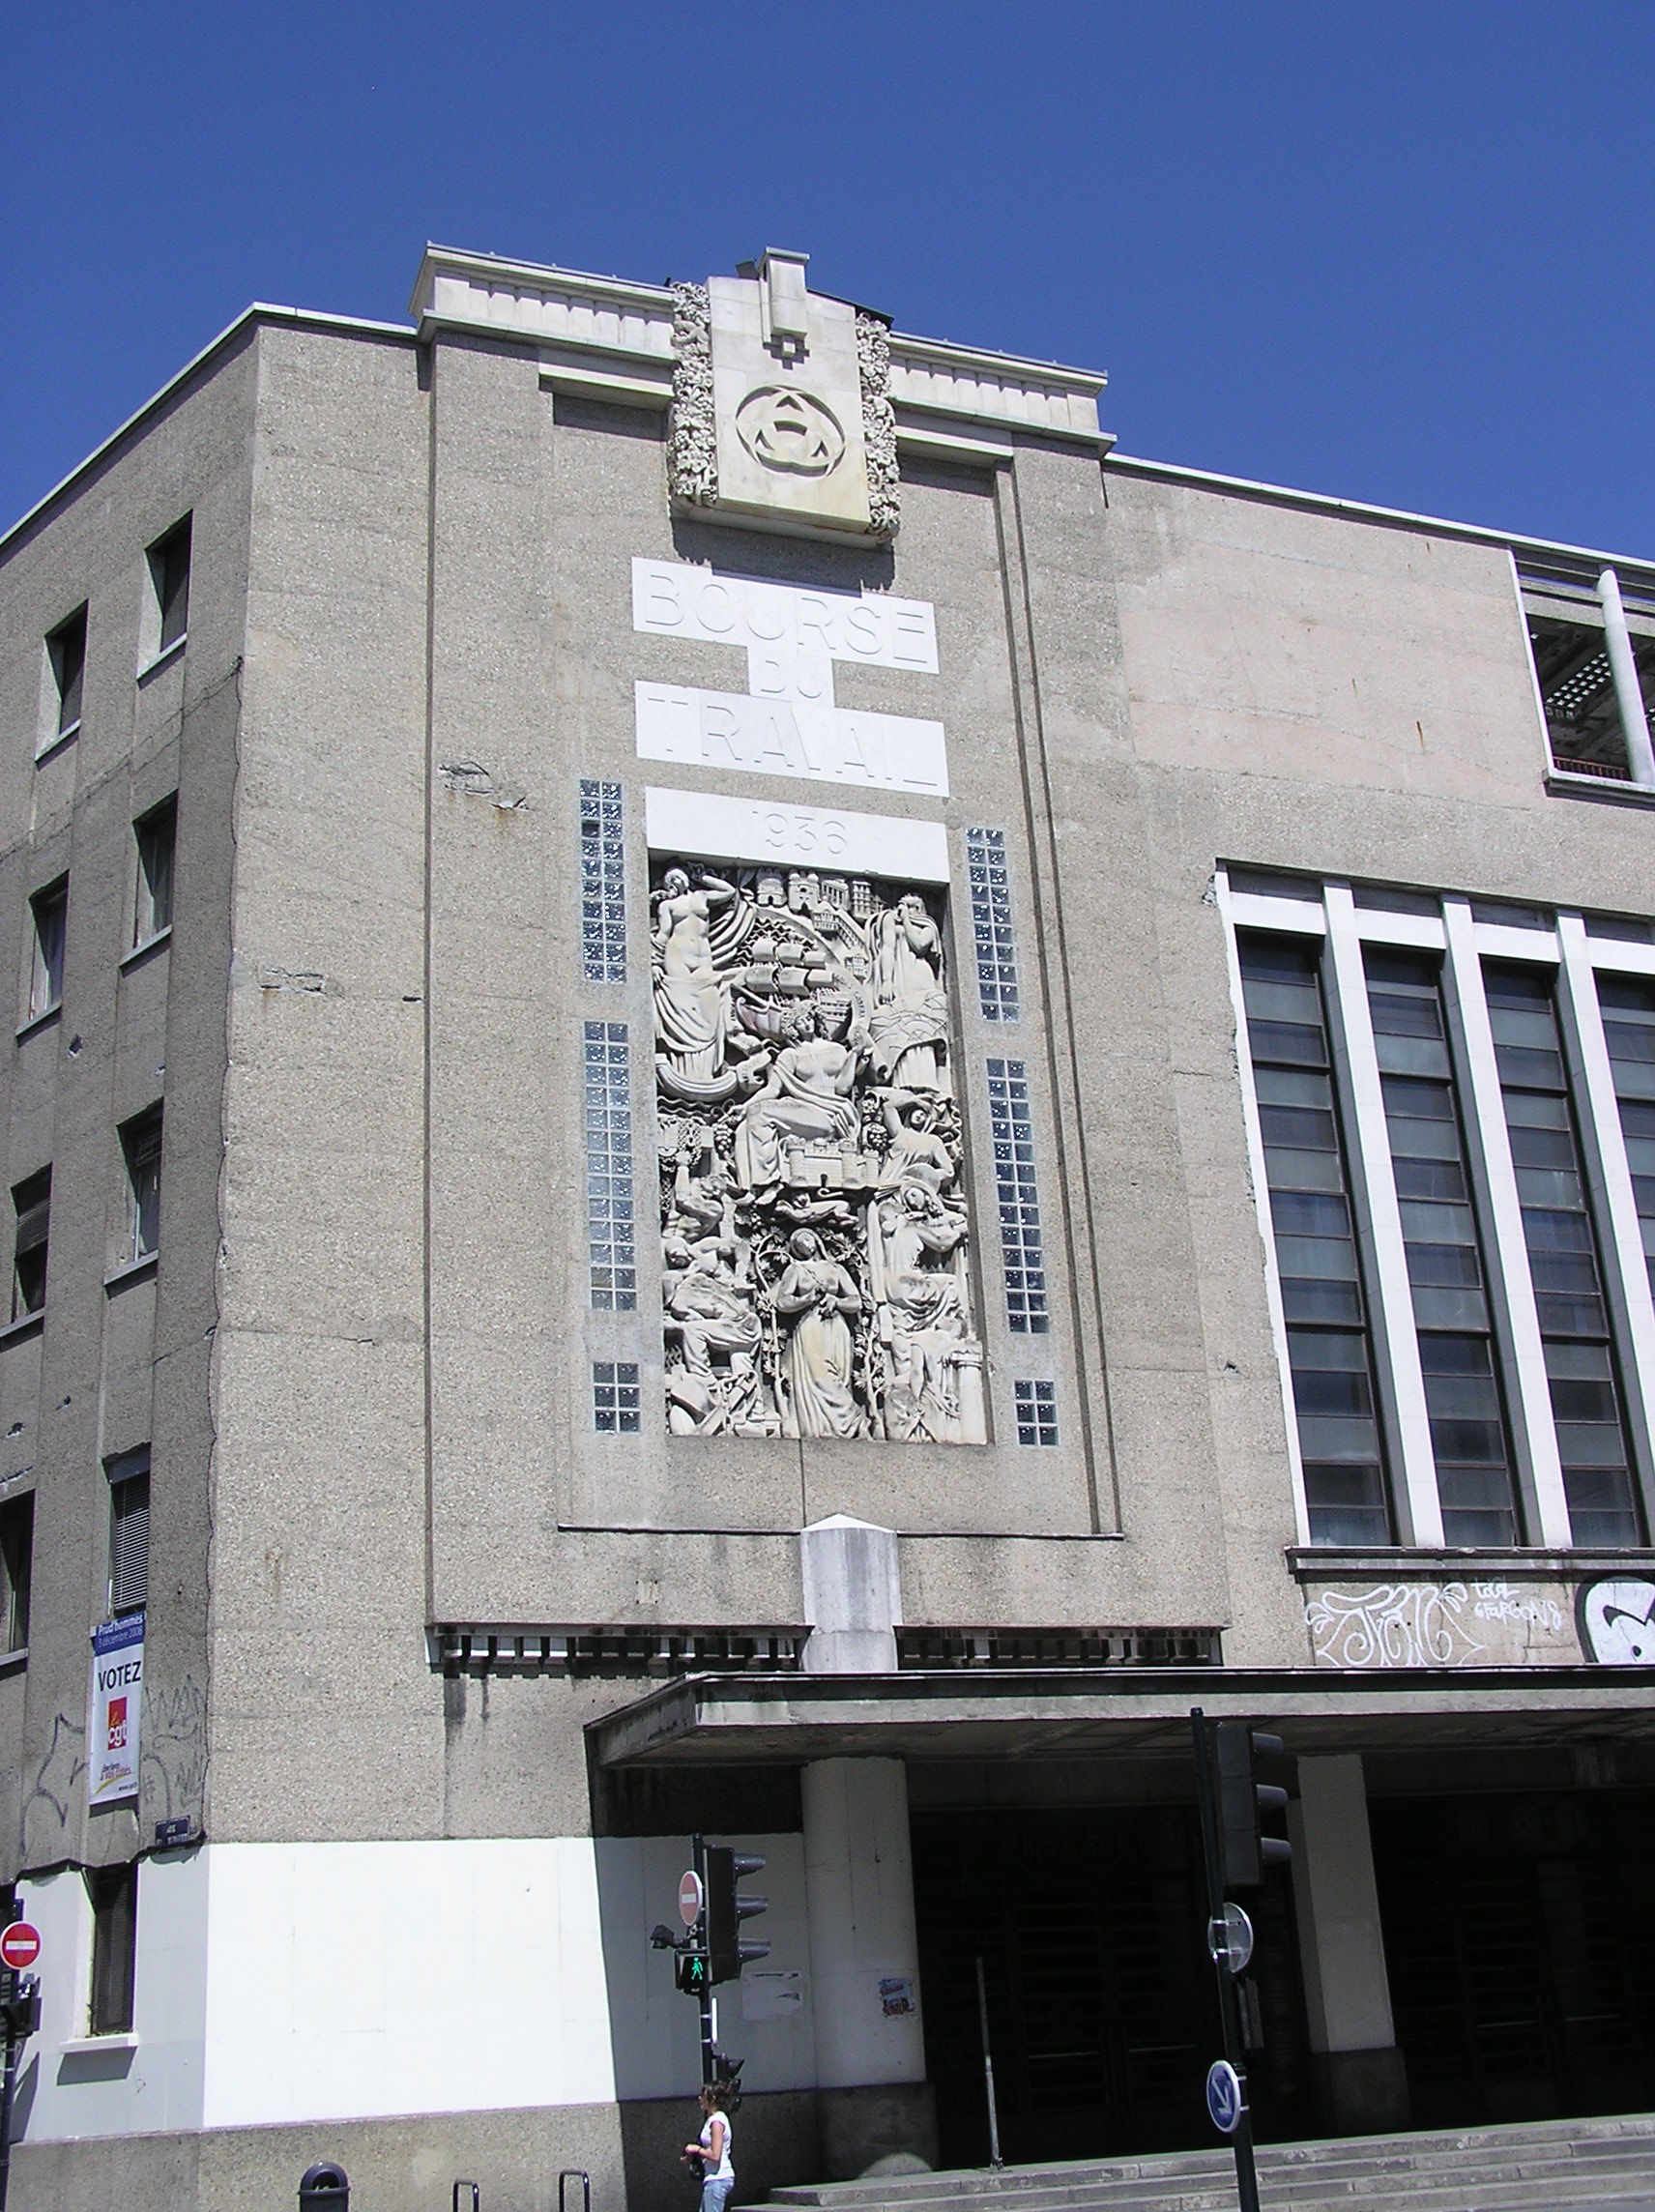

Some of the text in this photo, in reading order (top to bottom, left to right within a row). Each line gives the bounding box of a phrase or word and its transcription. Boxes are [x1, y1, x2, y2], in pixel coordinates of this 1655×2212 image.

[645, 574, 928, 664] BOURSE
[761, 659, 825, 699] DU
[99, 1661, 141, 1692] VOTEZ
[108, 1720, 128, 1747] cgt
